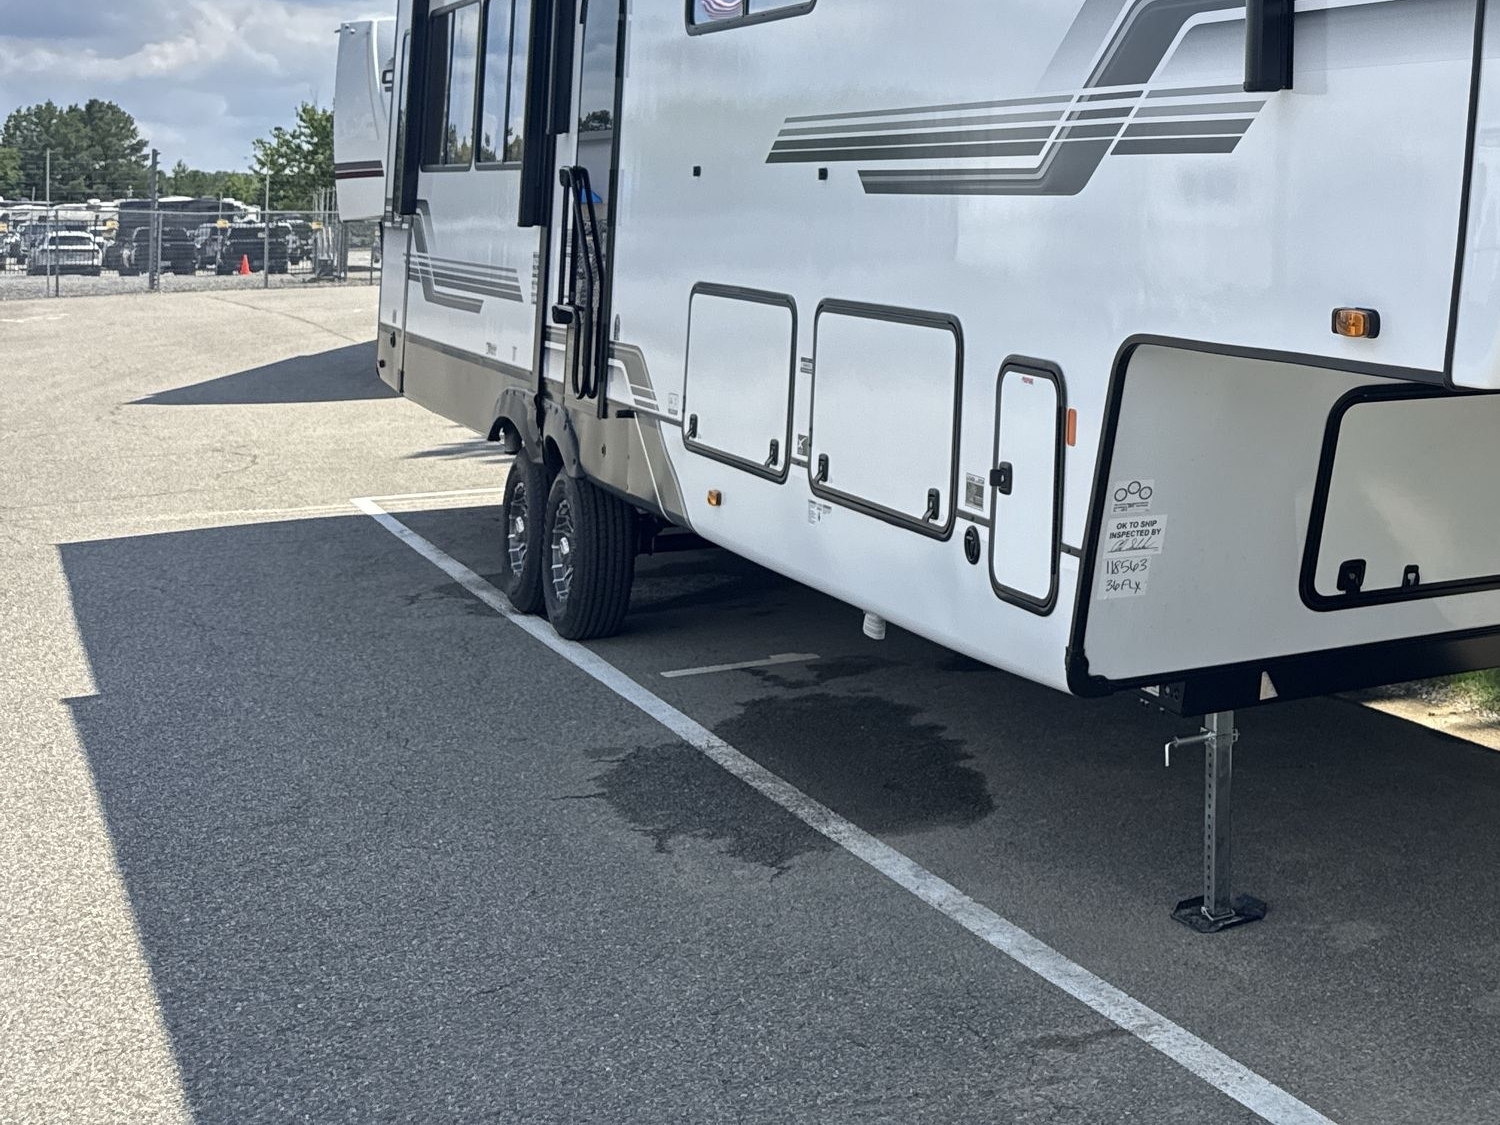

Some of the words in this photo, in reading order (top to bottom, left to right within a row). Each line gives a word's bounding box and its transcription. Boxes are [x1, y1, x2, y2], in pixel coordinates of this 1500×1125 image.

[1116, 522, 1128, 530] OK
[1140, 520, 1157, 528] SHIP
[1109, 529, 1150, 539] INSPECTED
[1151, 528, 1161, 536] BY
[1106, 558, 1148, 575] 118563
